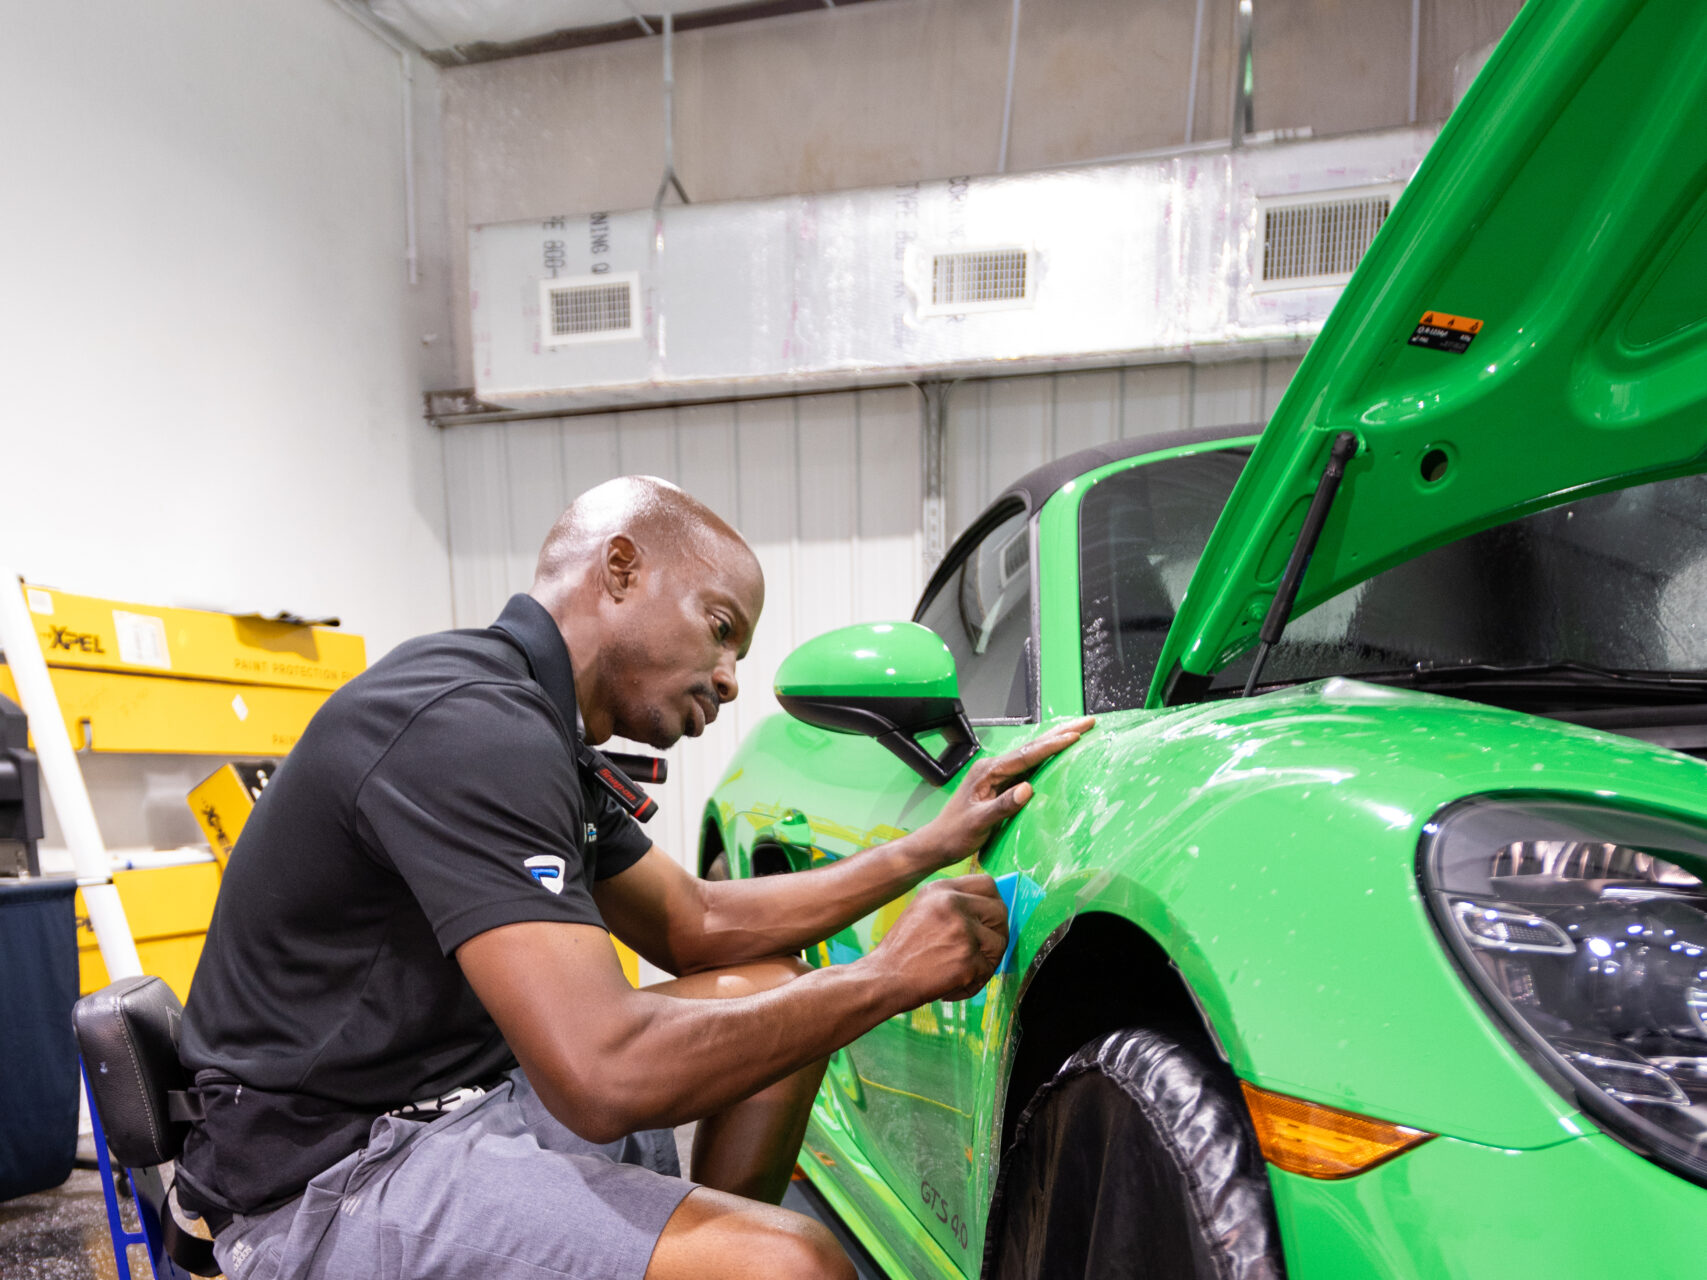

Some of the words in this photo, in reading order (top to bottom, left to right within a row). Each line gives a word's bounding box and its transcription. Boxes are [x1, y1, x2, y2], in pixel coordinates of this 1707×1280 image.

[49, 624, 105, 654] XPEL
[233, 657, 267, 673] PAINT
[271, 662, 339, 681] PROTECTION
[920, 1180, 949, 1225] GTS
